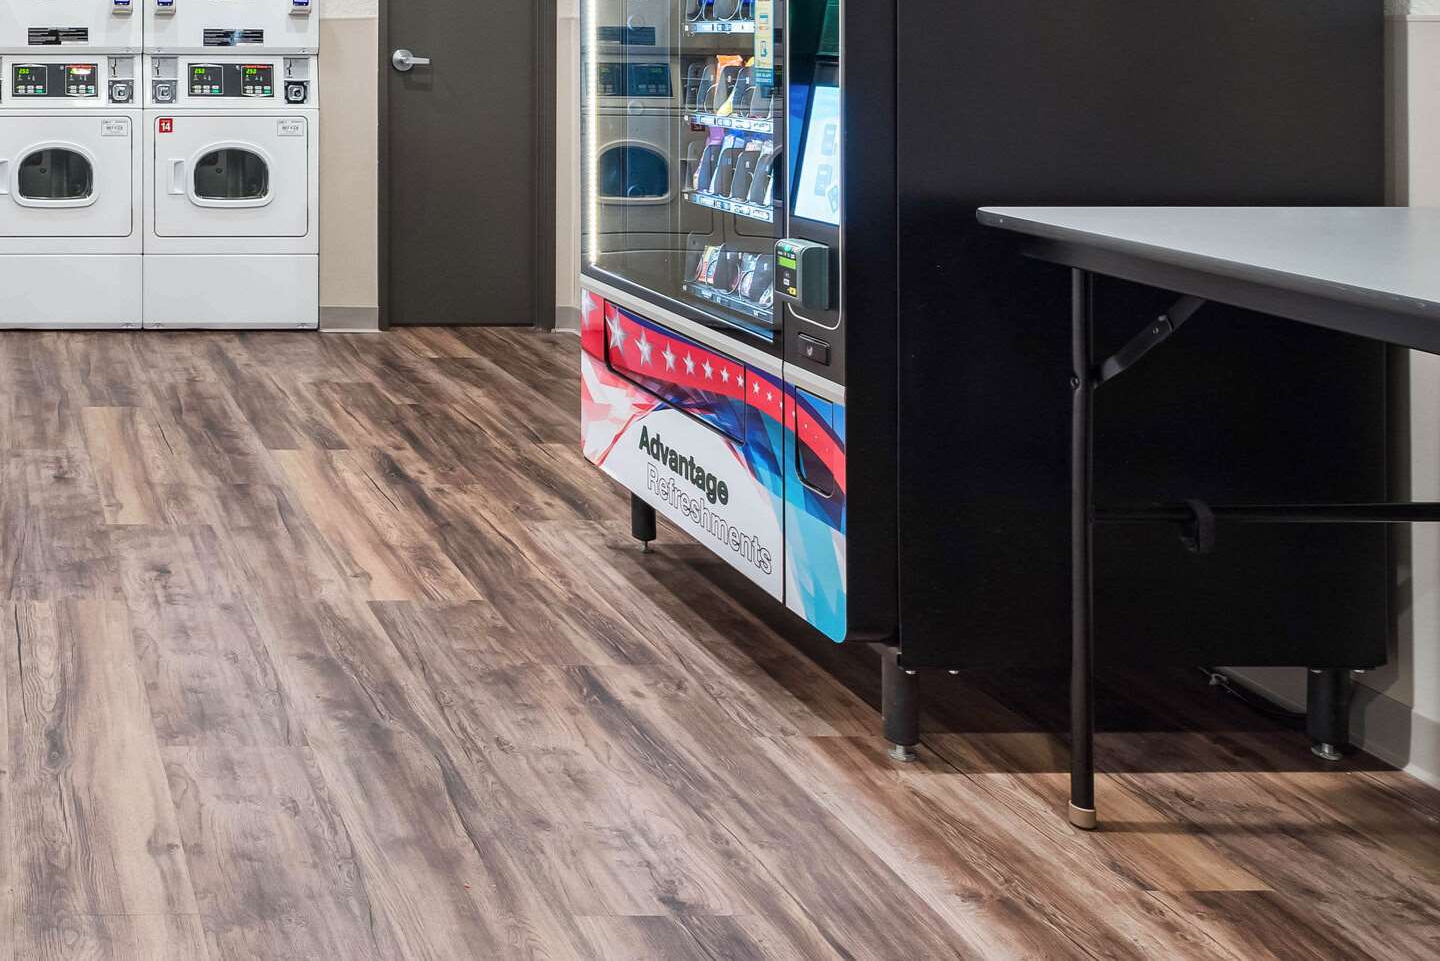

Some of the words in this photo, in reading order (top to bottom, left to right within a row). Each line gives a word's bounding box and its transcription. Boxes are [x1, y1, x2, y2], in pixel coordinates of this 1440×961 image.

[161, 122, 171, 131] 14
[638, 425, 729, 506] Advantage
[647, 462, 773, 575] Refreshments
